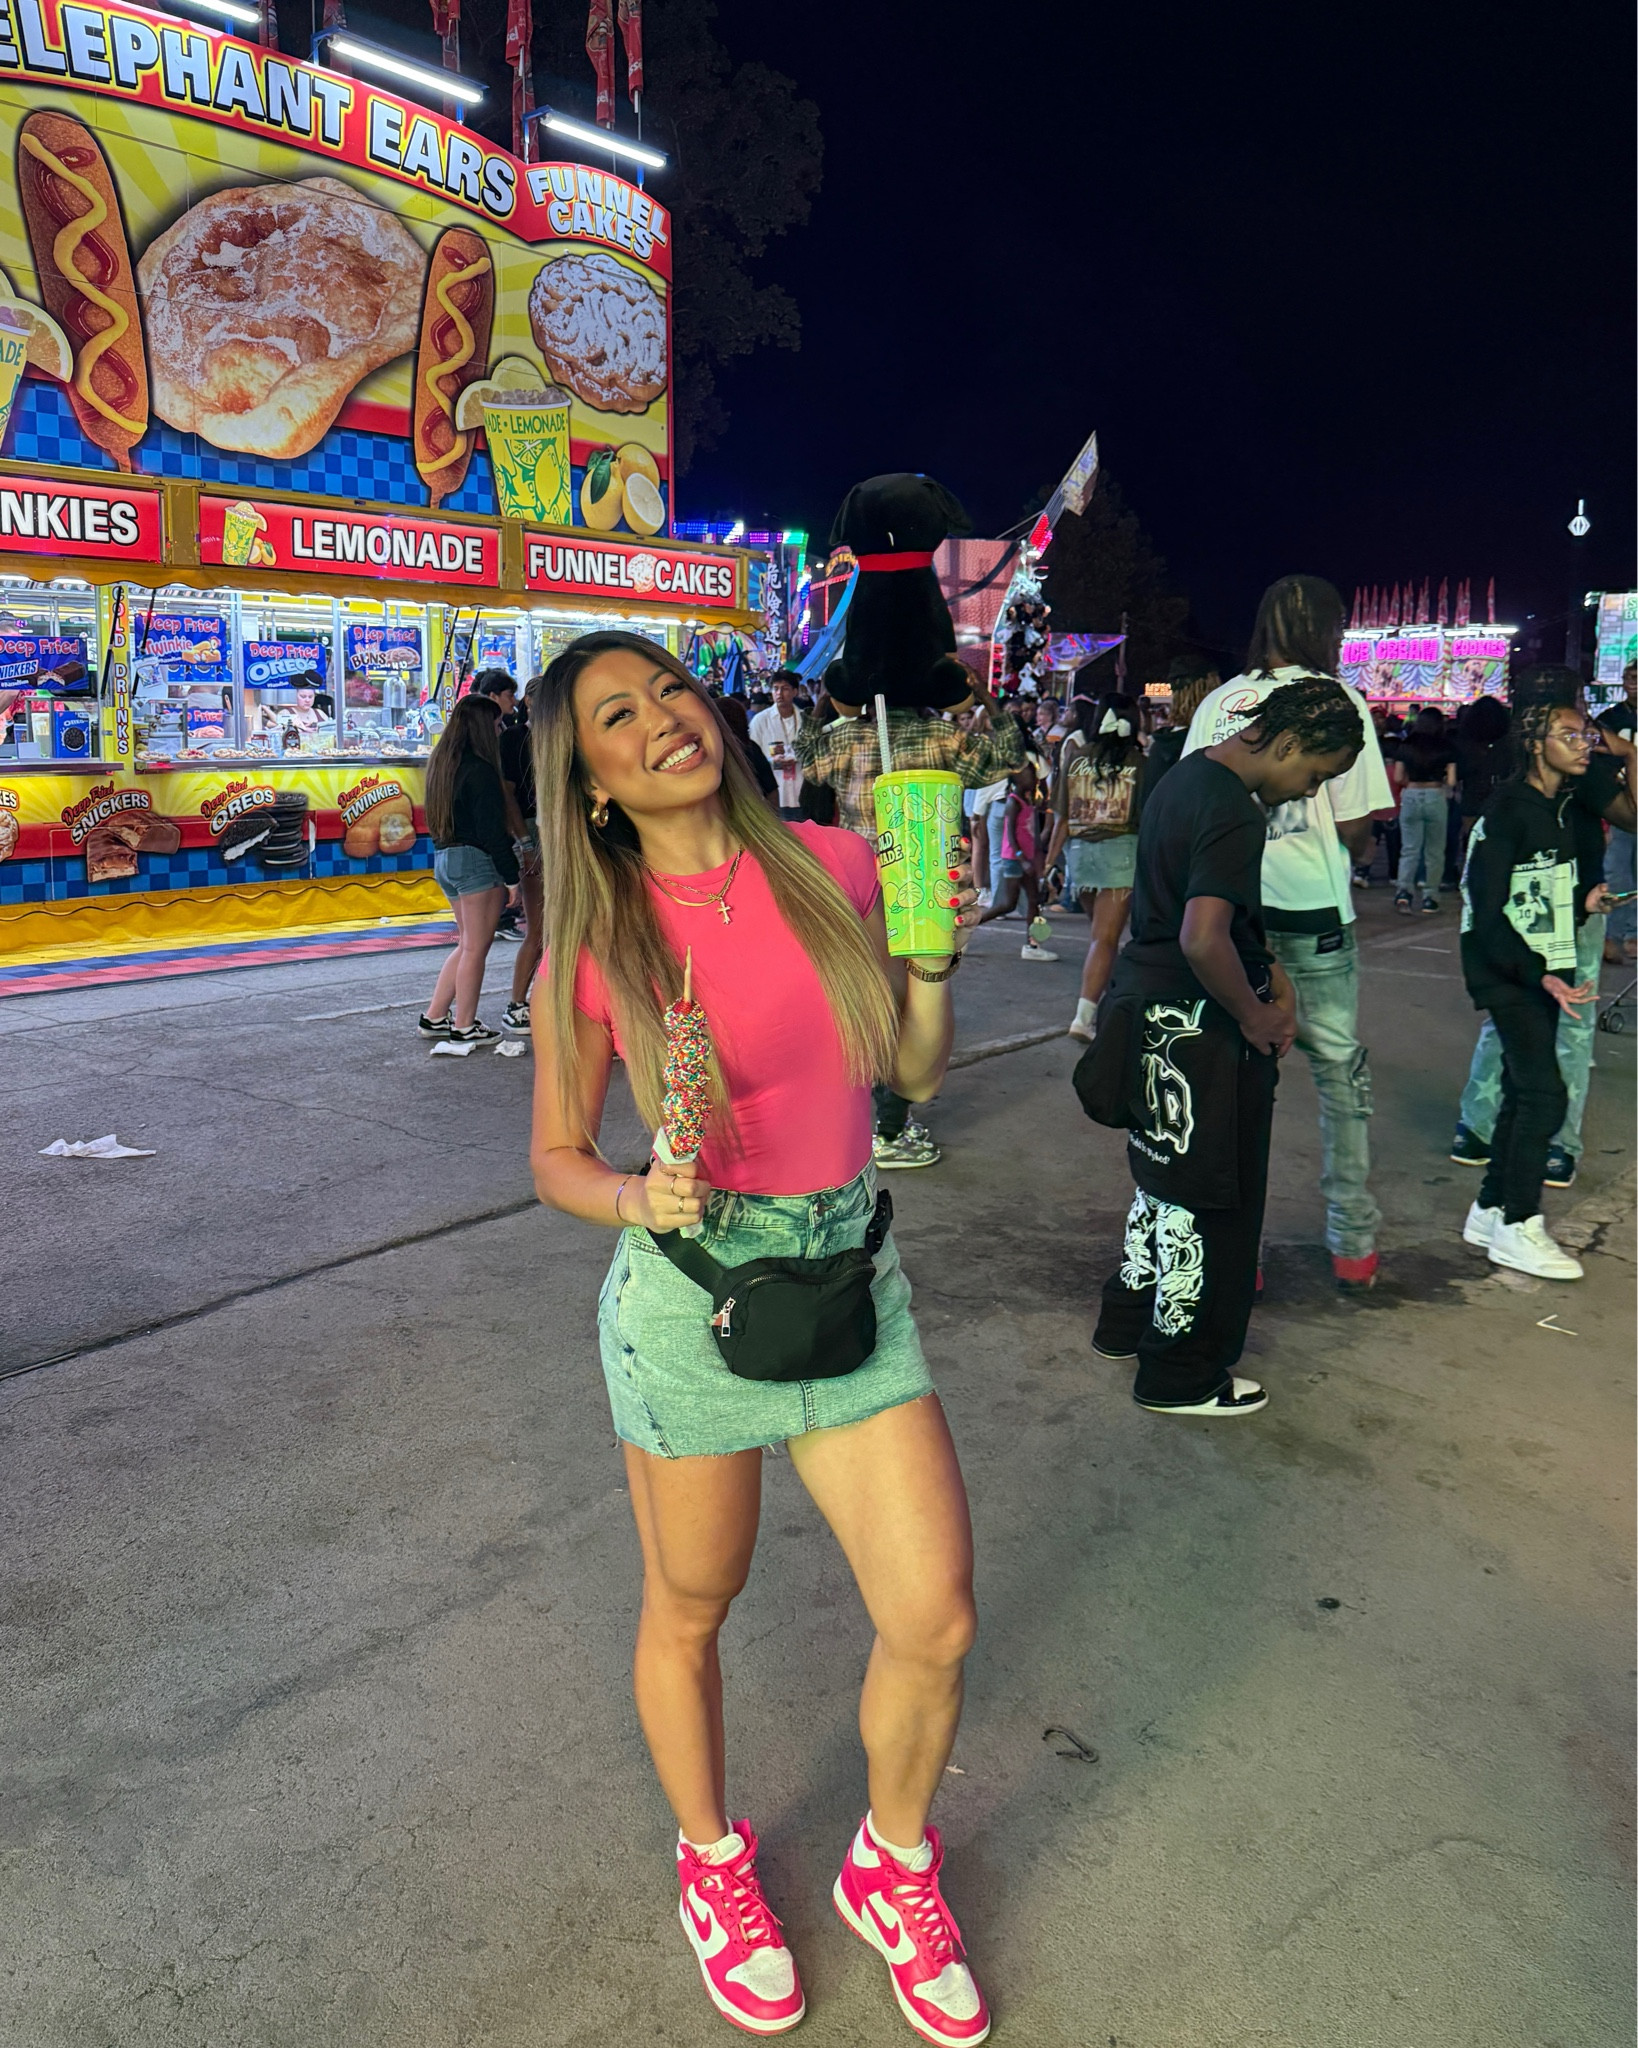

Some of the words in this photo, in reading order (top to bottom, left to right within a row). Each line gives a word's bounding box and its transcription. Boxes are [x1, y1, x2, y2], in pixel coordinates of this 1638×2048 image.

[370, 99, 515, 217] EARS
[527, 167, 667, 246] FUNNEL
[549, 201, 653, 260] CAKES
[509, 412, 566, 435] LEMONADE
[0, 489, 139, 546] NKIES
[292, 517, 484, 574] LEMONADE
[529, 543, 634, 588] FUNNEL
[654, 559, 733, 598] CAKES
[39, 638, 79, 655] Fried
[184, 616, 220, 634] Fried
[387, 627, 417, 643] Fried
[249, 643, 284, 660] Deep
[286, 644, 319, 659] Fried
[351, 651, 387, 669] BUNS
[1342, 640, 1371, 666] ICE
[1375, 637, 1438, 663] CREAM
[1452, 639, 1507, 659] COOKIES
[115, 662, 130, 755] DRINKS
[72, 791, 150, 845] SNICKERS
[210, 787, 274, 834] OREOS
[341, 782, 400, 828] TWINKIES
